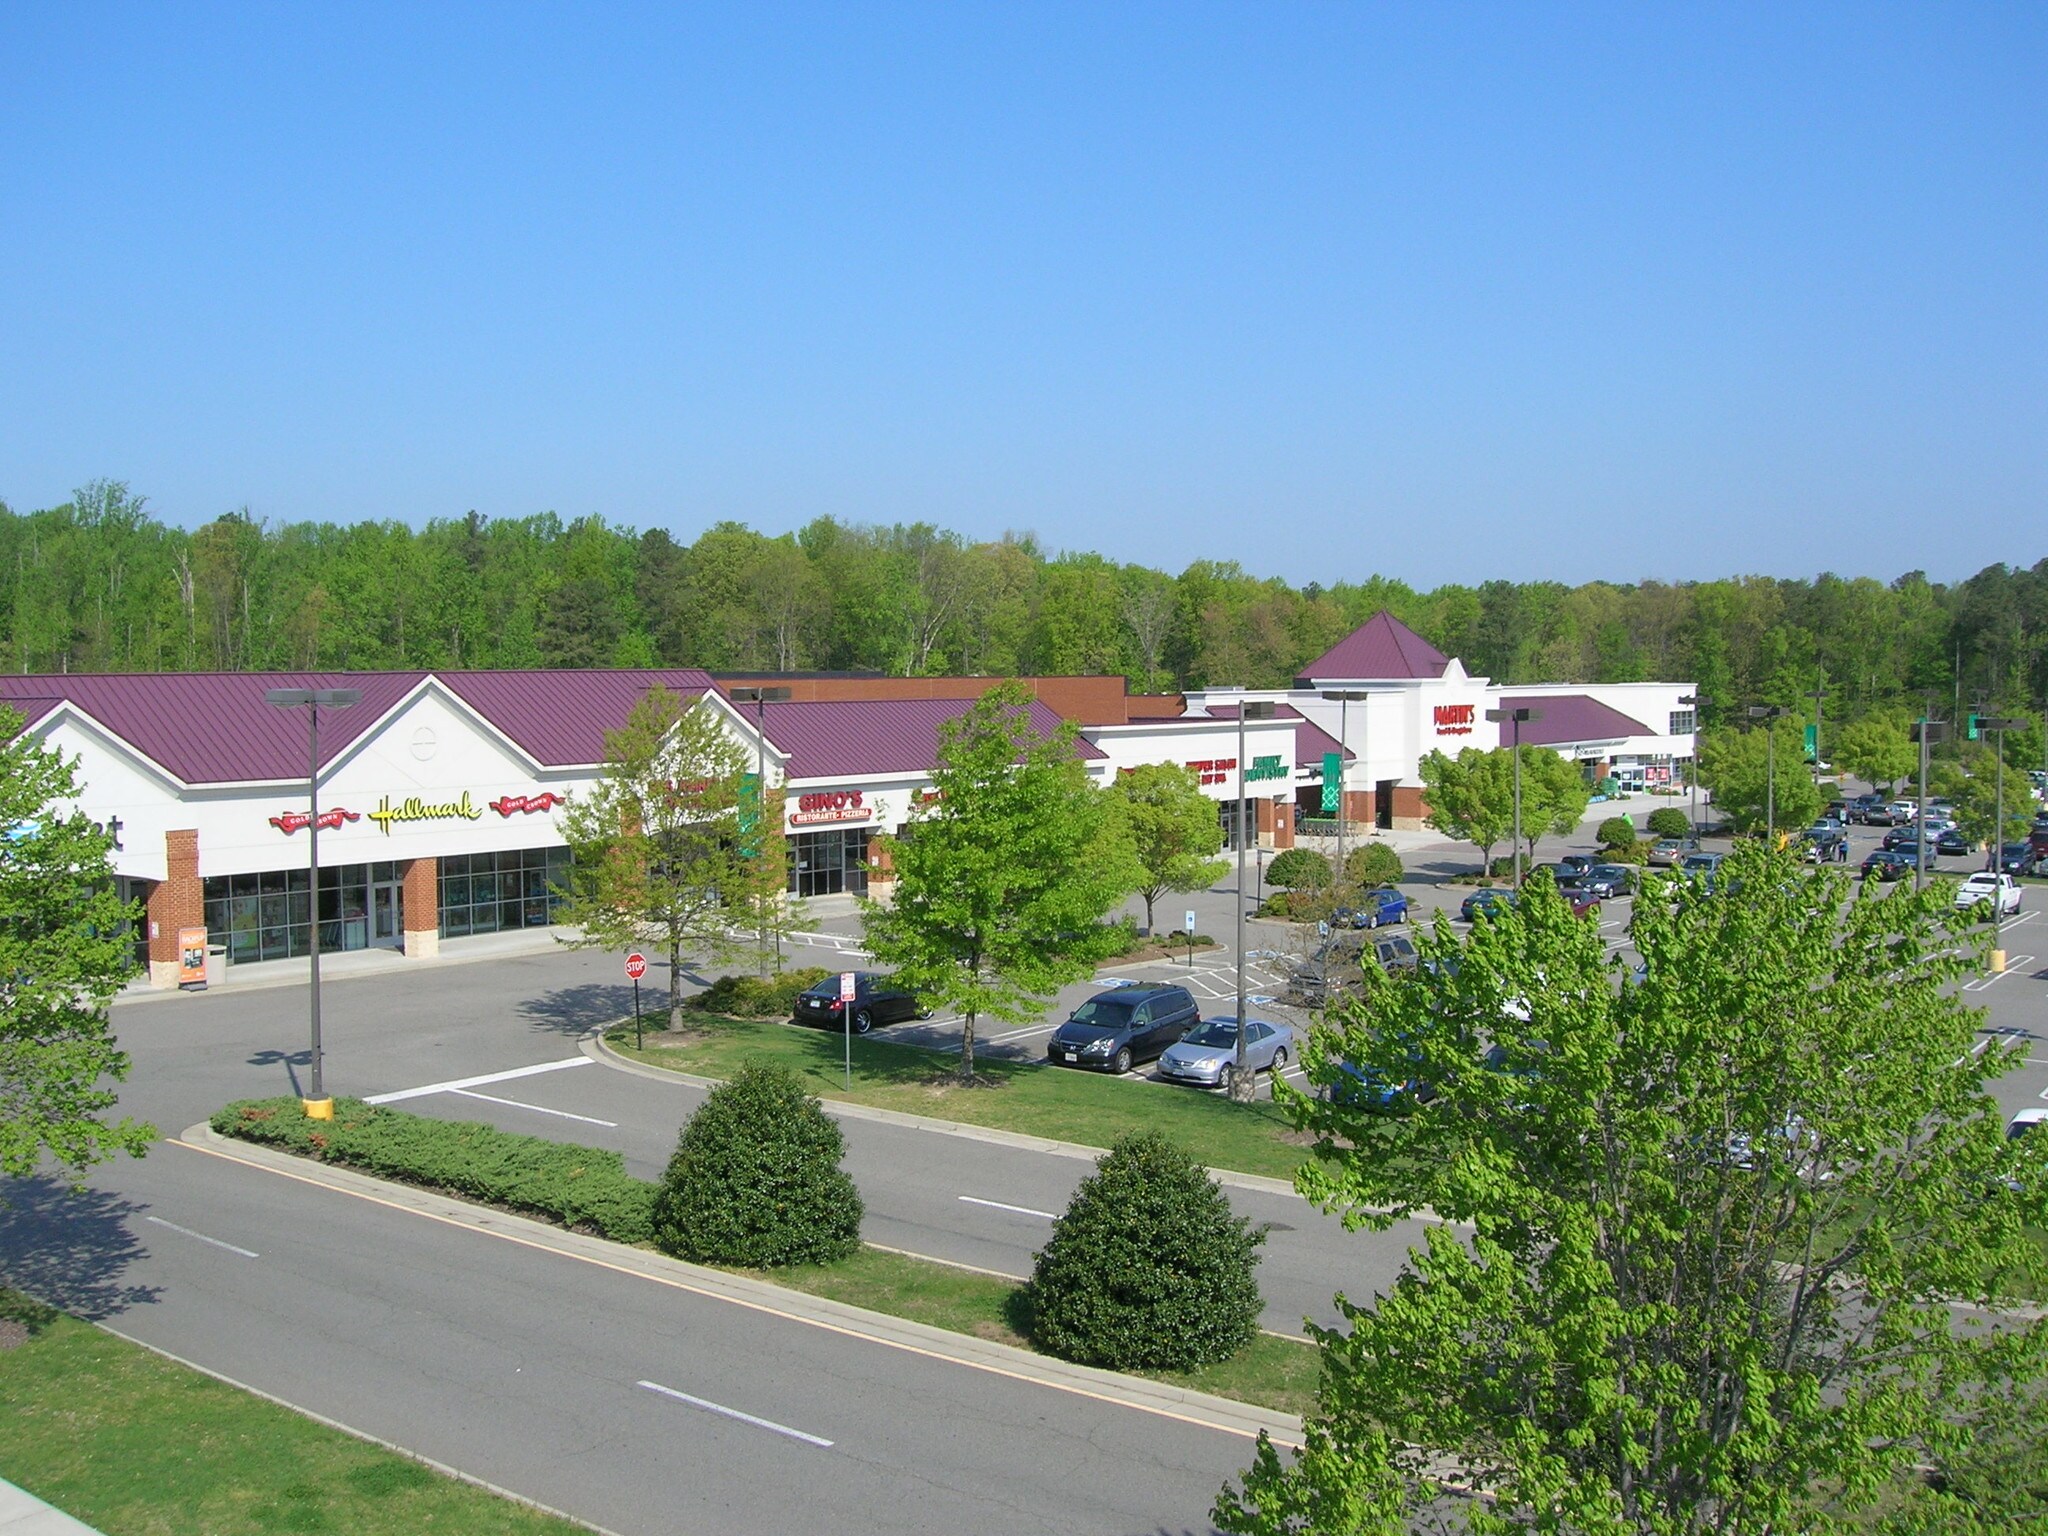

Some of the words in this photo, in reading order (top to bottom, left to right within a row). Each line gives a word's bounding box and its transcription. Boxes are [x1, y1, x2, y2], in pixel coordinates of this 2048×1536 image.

[1433, 704, 1475, 726] MARTIN'S
[1215, 758, 1237, 771] SALON
[1253, 755, 1282, 769] FAMILY
[1244, 766, 1290, 782] DENTISTRY
[506, 799, 524, 808] GOLD
[799, 789, 863, 812] GINO'S
[317, 814, 338, 826] ROWN
[367, 790, 482, 837] Hallmark
[796, 811, 837, 823] RISTORANTE
[841, 808, 870, 819] PIZZERIA
[627, 960, 645, 972] STOP
